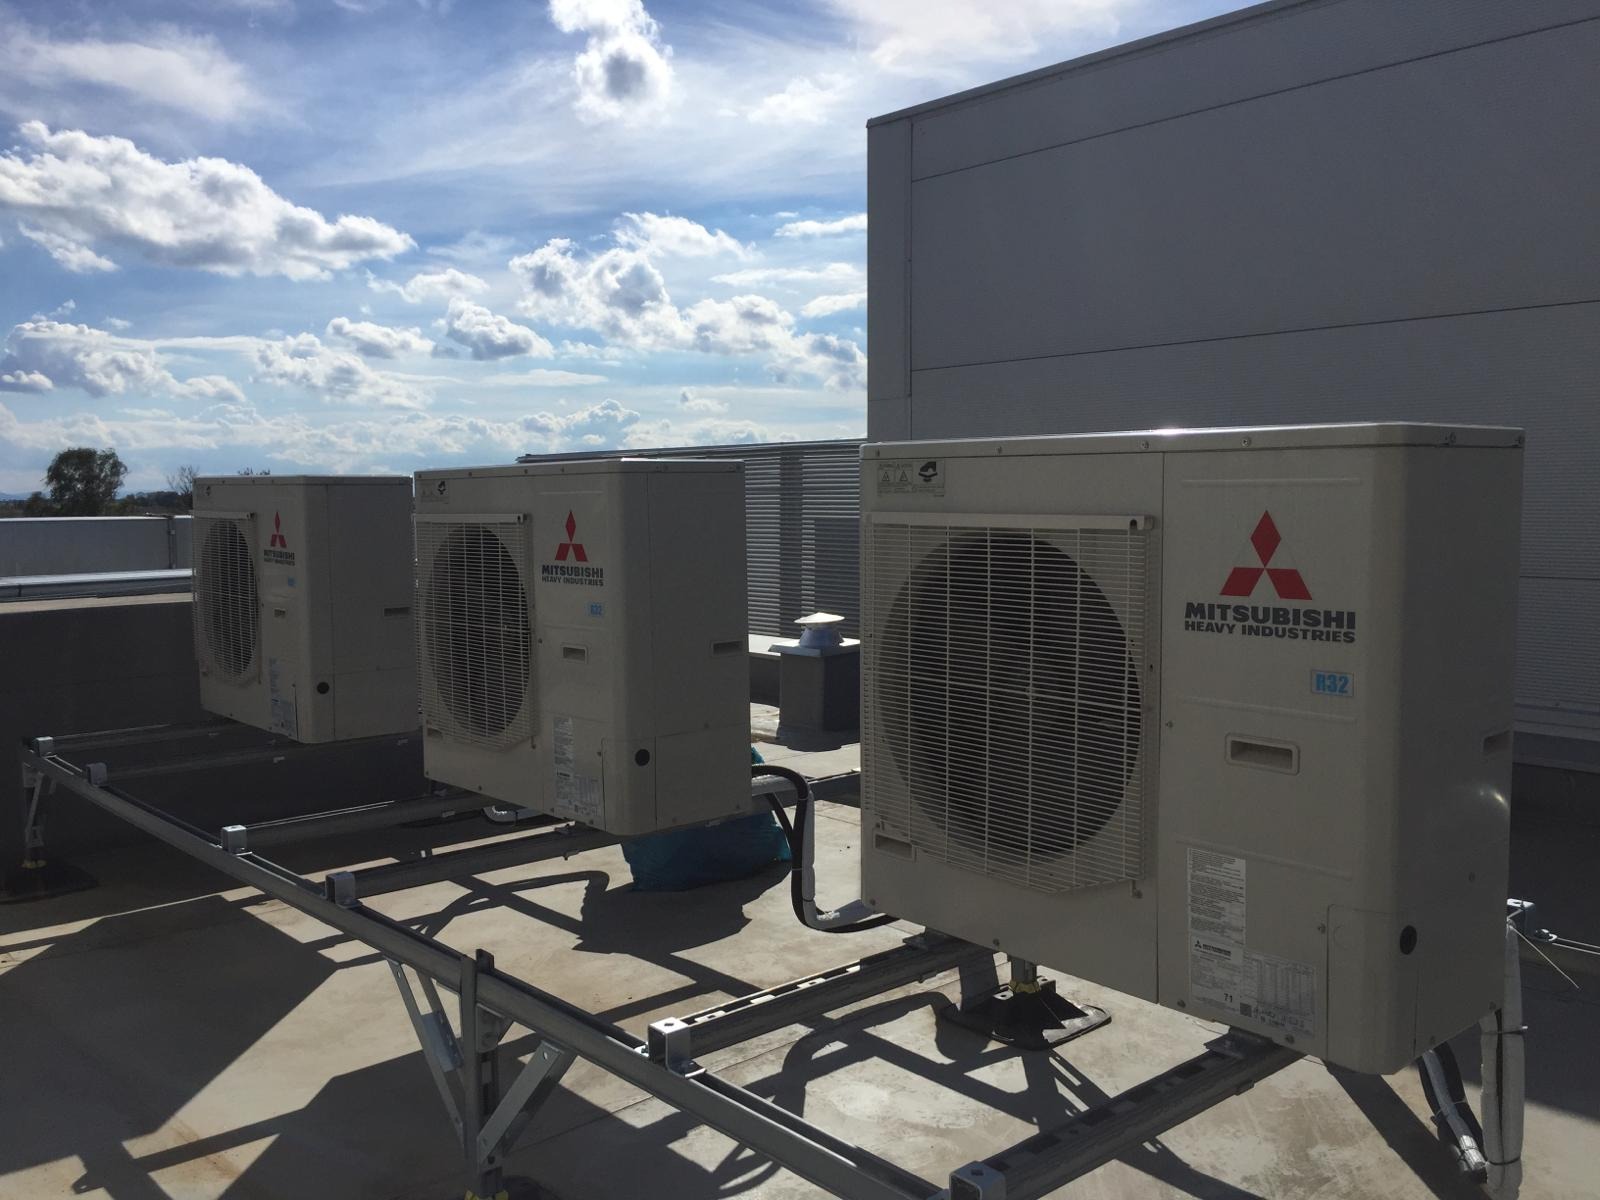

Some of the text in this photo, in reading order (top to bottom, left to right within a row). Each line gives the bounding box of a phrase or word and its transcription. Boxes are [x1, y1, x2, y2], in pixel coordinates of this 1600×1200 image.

[542, 565, 604, 578] MITSUBISHI
[542, 576, 604, 587] HEAVY INDUSTRIES
[1184, 602, 1356, 630] MITSUBISHI
[1184, 621, 1356, 643] HEAVY INDUSTRIES
[1315, 672, 1349, 694] R32
